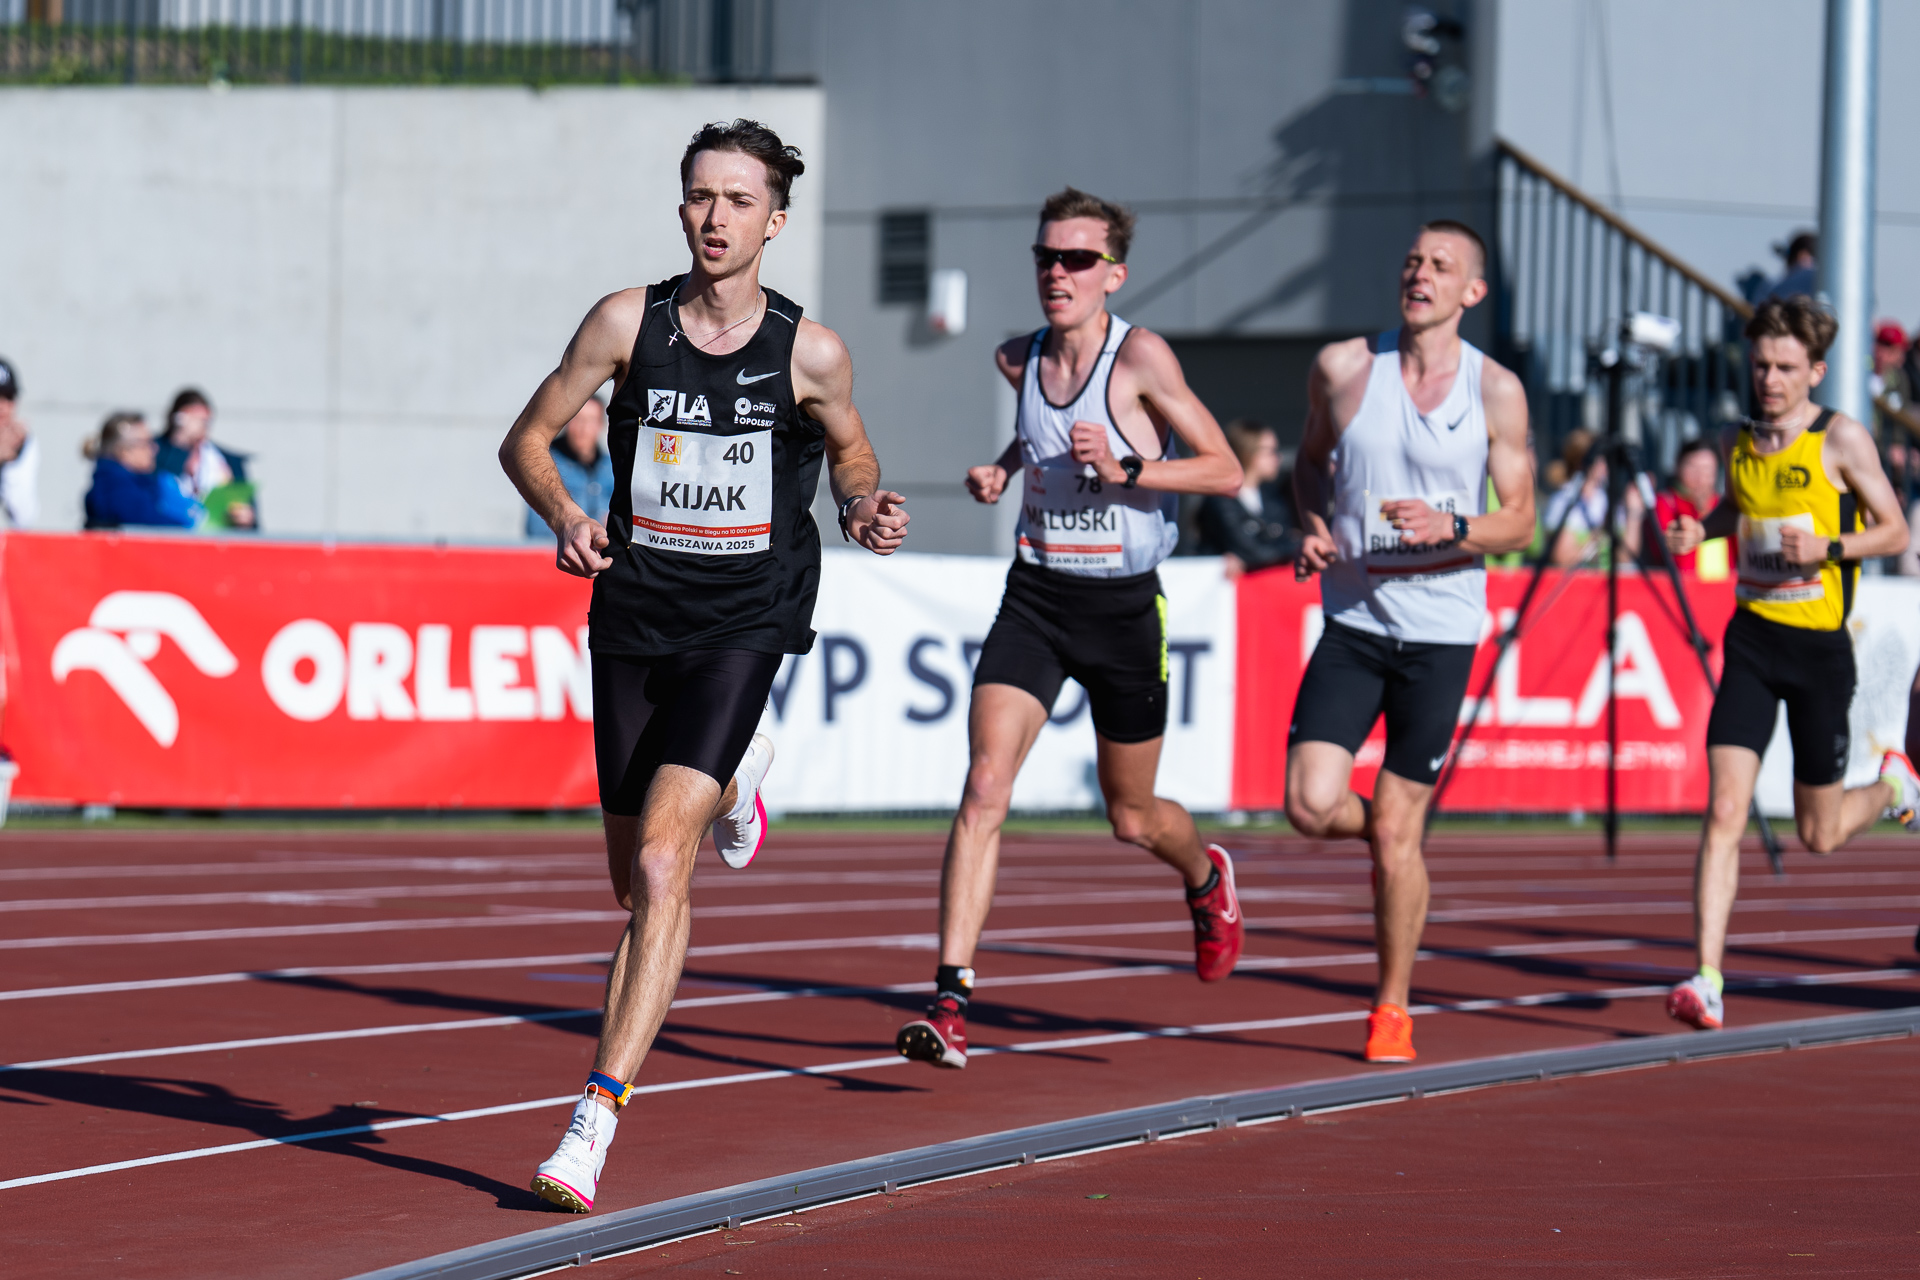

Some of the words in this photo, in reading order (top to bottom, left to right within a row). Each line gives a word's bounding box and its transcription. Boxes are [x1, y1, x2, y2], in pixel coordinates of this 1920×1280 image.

[752, 404, 776, 413] OPOLE
[655, 452, 678, 463] PZLA
[723, 441, 754, 465] 40
[1075, 474, 1102, 494] 78
[660, 481, 746, 511] KIJAK
[638, 518, 650, 526] PZLA
[650, 522, 681, 531] Mistrzostwa
[648, 534, 723, 551] WARSZAWA
[726, 540, 755, 550] 2025
[262, 618, 594, 722] ORLEN
